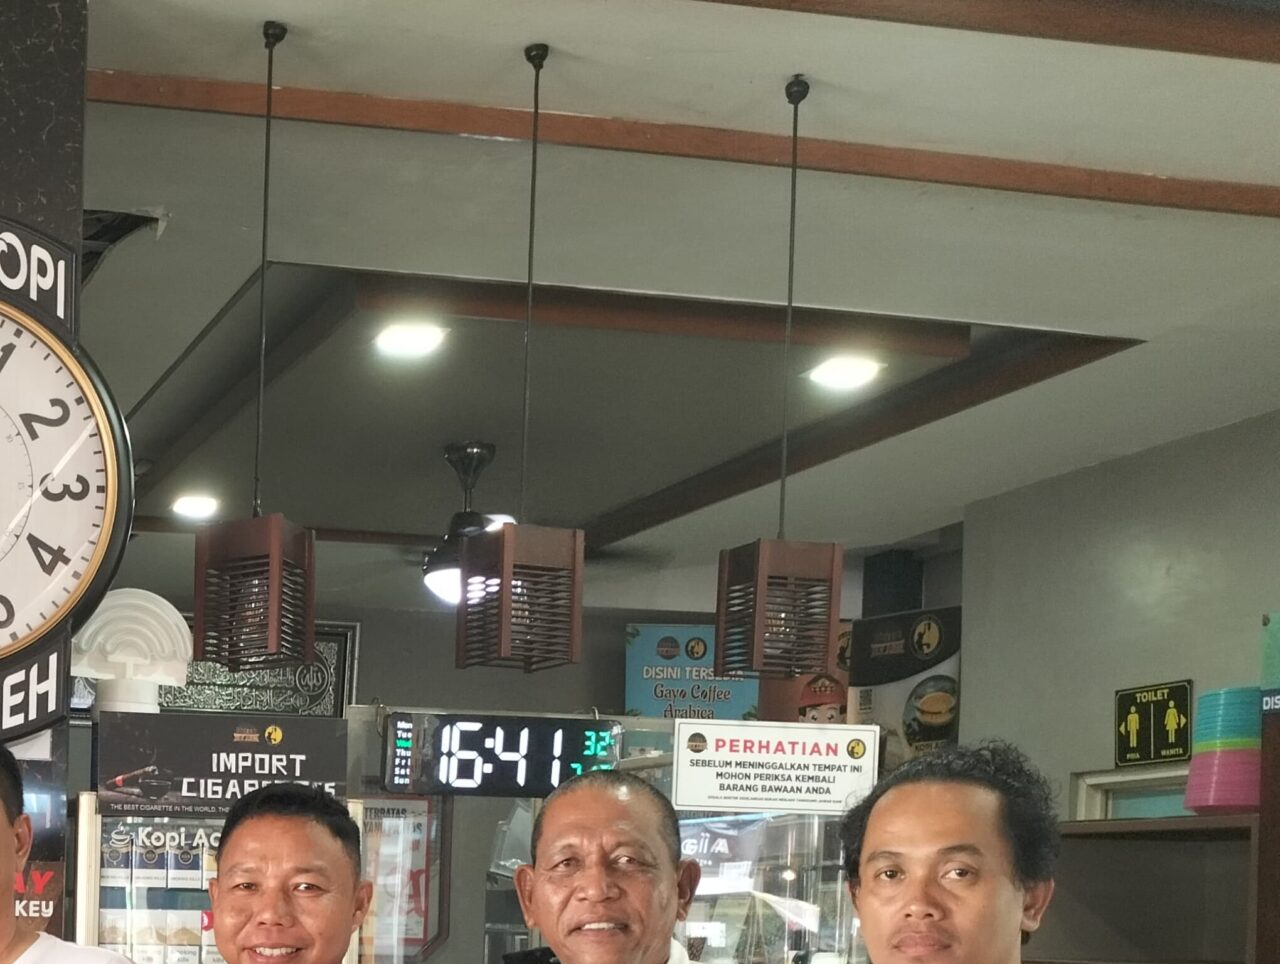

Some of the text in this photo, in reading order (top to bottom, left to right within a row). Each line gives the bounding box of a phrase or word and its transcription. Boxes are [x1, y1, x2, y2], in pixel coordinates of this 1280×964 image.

[18, 398, 70, 441] 2
[39, 472, 90, 502] 3
[26, 532, 71, 576] 4
[643, 666, 744, 681] DISINI TERS
[654, 683, 731, 703] Gayo Coffee
[1135, 688, 1169, 703] TOILET
[664, 703, 714, 719] Arabica
[439, 721, 563, 788] 16:41
[715, 738, 839, 757] PERHATIAN
[212, 752, 306, 777] IMPORT
[689, 759, 862, 773] SEBELUM MENINGGALKAN TEMPAT INI
[716, 771, 836, 783] MOHON PERIKSA KEMBALI
[181, 778, 336, 799] CIGARS
[719, 783, 831, 795] BARANG BAWAAN ANDA
[140, 804, 173, 812] CIGARETTE
[138, 826, 221, 851] Kopi Ac
